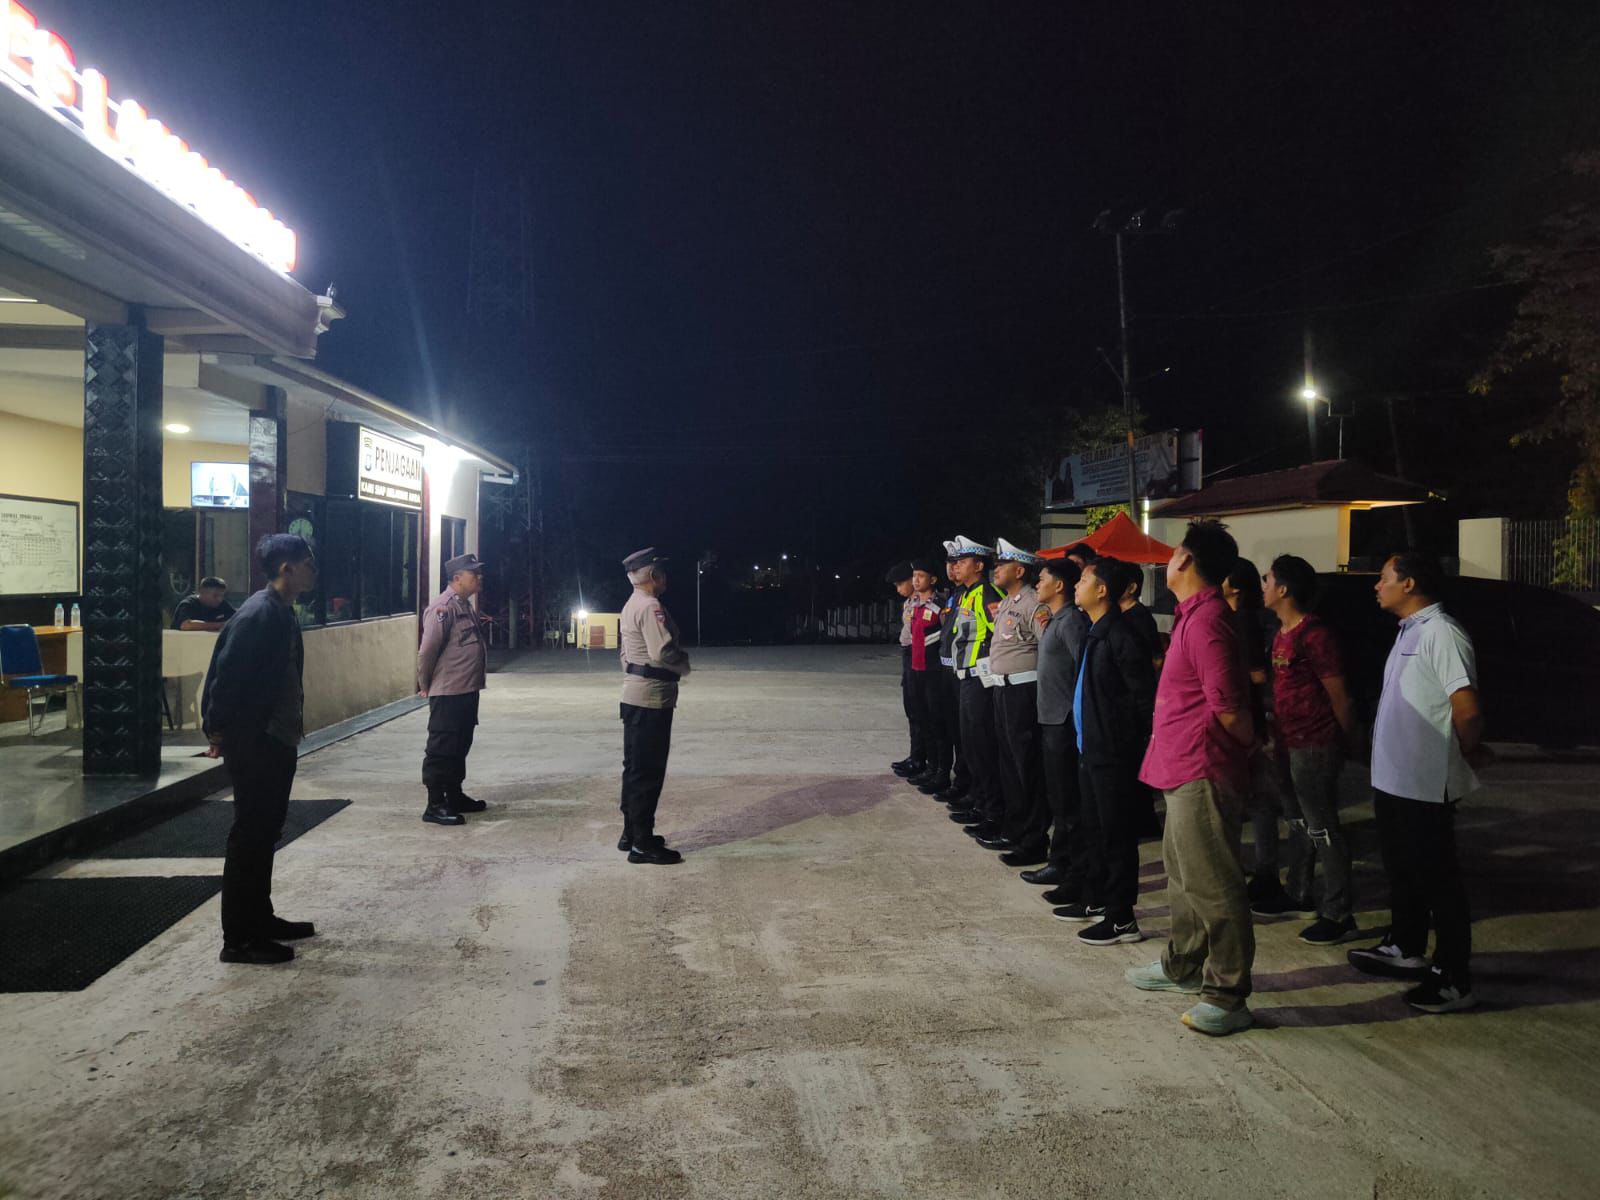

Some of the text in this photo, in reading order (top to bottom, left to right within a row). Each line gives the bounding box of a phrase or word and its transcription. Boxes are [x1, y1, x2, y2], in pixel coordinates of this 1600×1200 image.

[375, 447, 421, 481] PENJAGAAN
[1080, 437, 1151, 465] SELAMAT JAN
